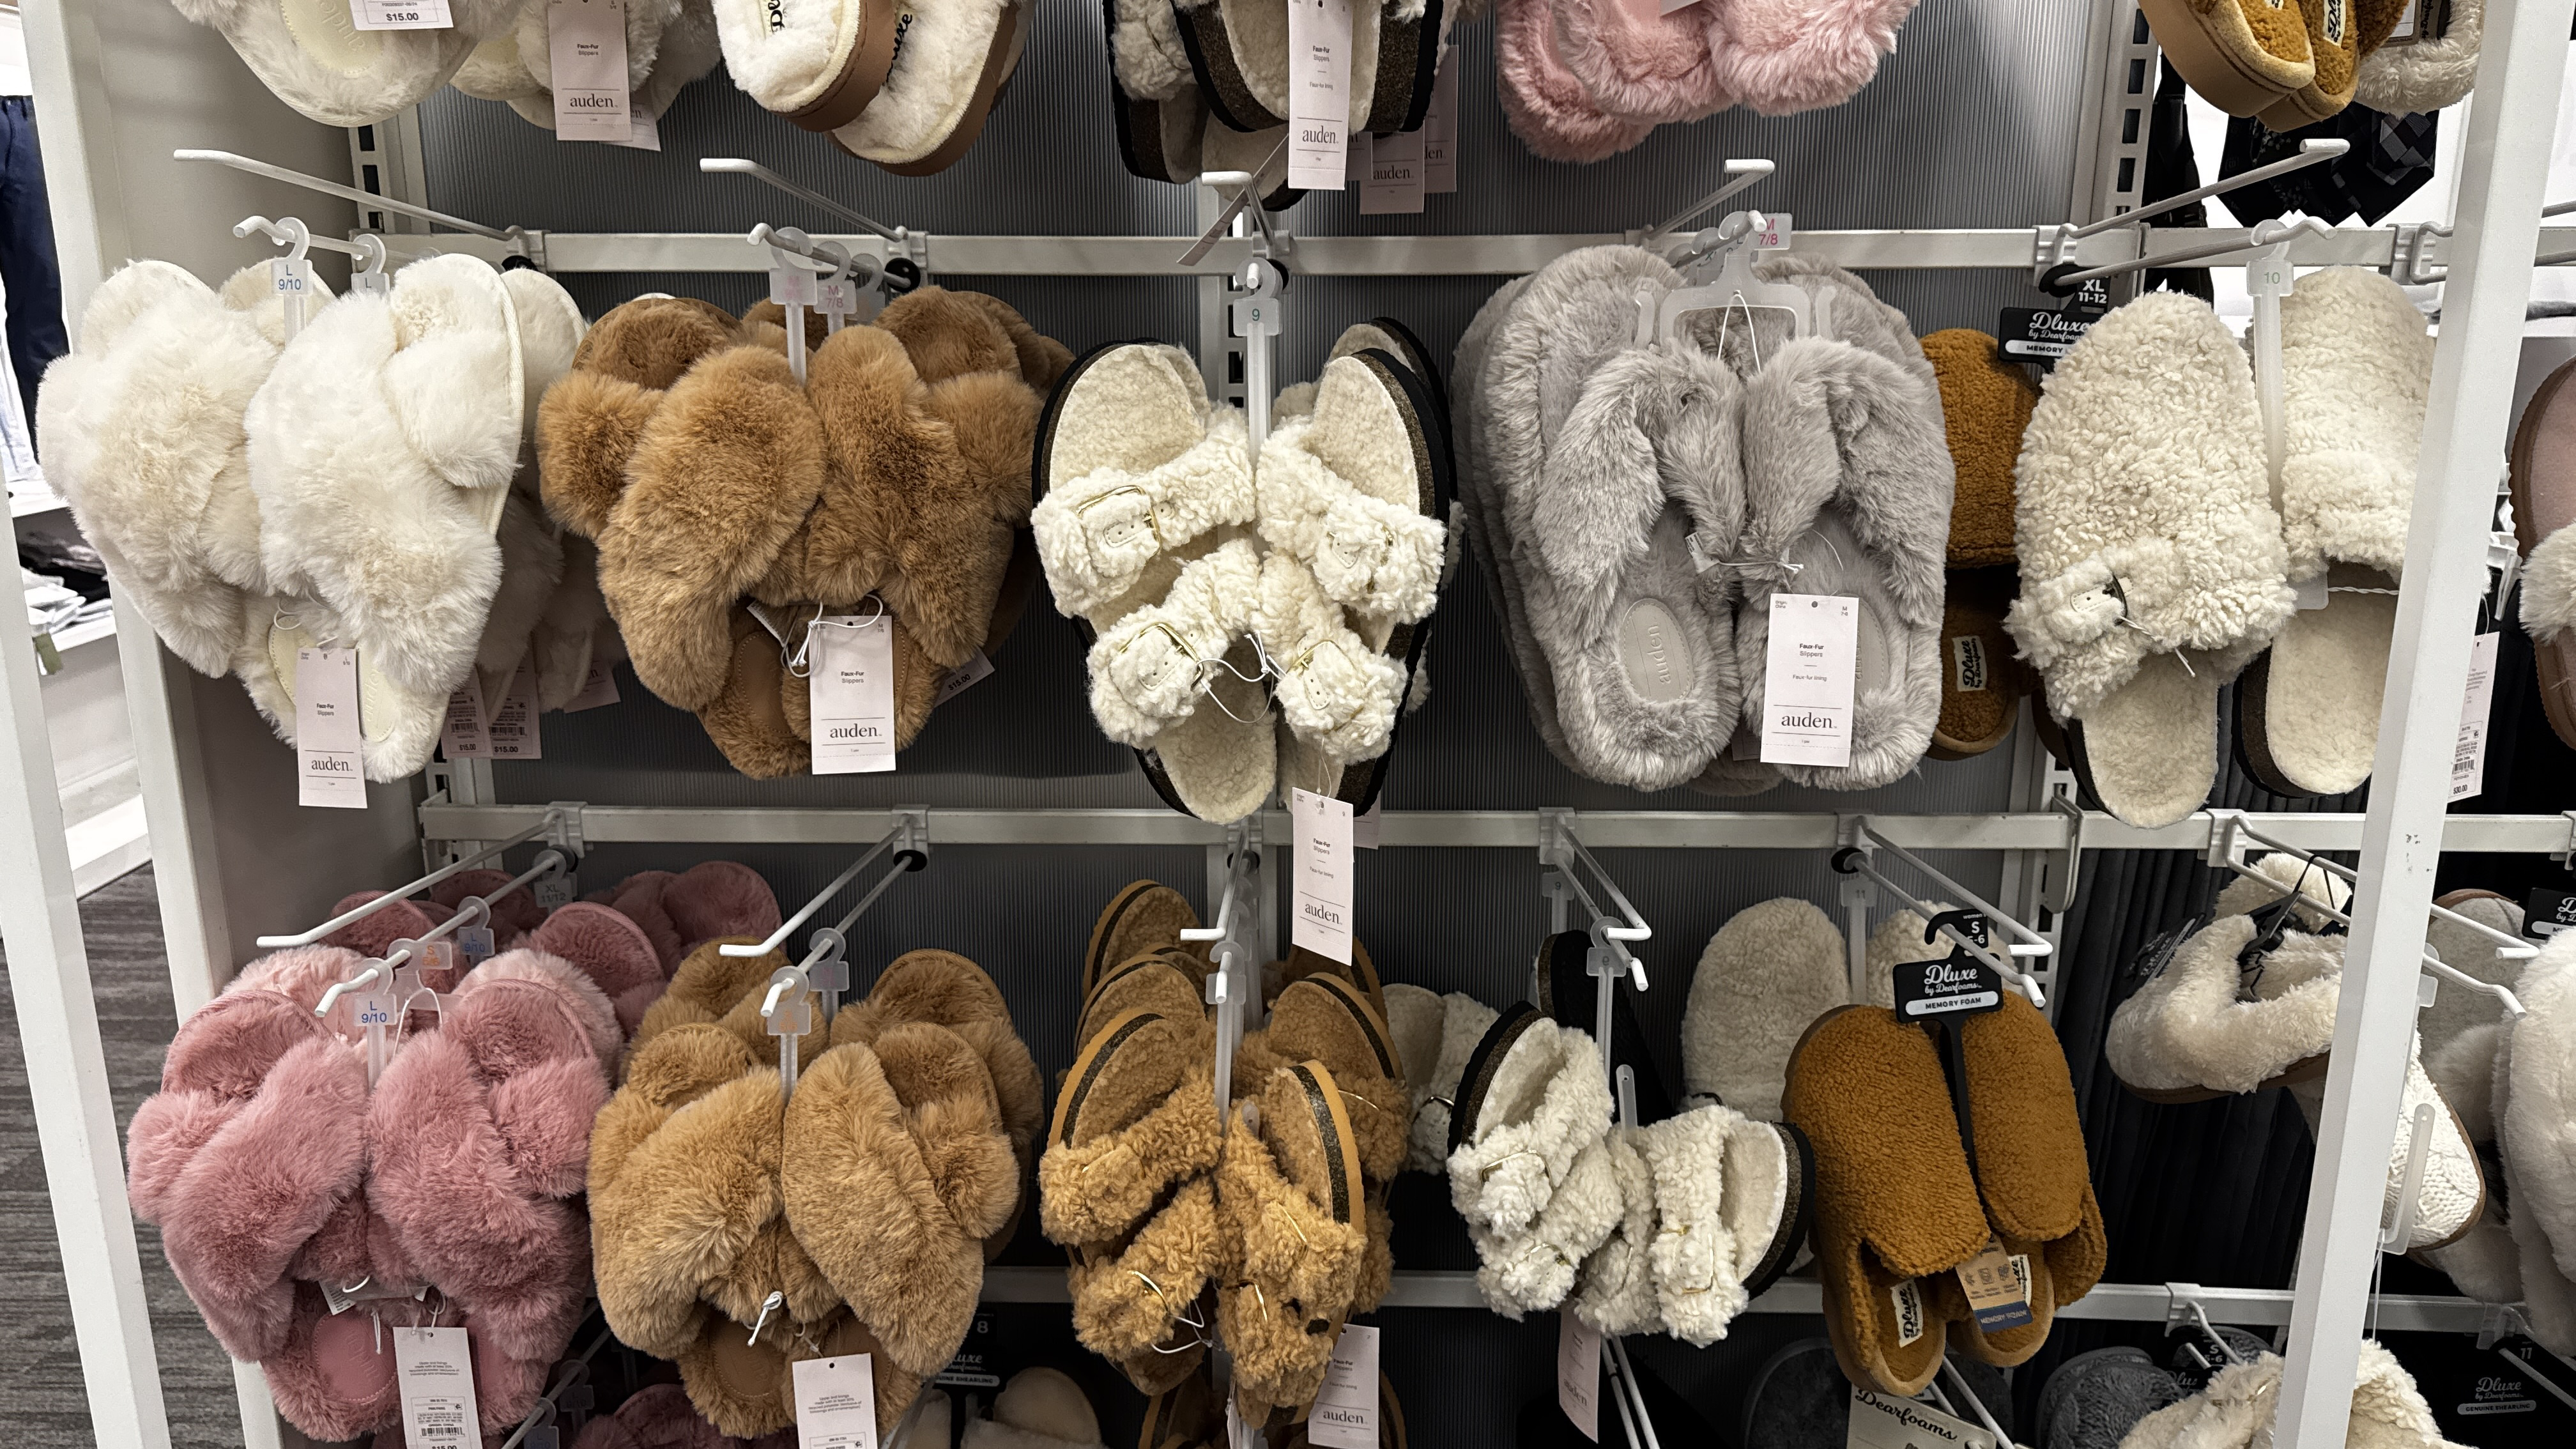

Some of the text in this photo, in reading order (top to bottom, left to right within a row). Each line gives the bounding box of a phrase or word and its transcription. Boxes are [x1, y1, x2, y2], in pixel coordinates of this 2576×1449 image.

[386, 13, 419, 22] $15.00
[570, 93, 614, 108] auden
[1302, 125, 1337, 144] auden
[1374, 165, 1411, 181] auden
[1758, 234, 1779, 246] 7/8
[286, 264, 293, 276] L
[365, 277, 372, 289] L
[2264, 272, 2281, 284] 10
[278, 279, 302, 291] 9/10
[827, 285, 839, 296] M
[2082, 279, 2105, 293] XL
[825, 298, 844, 308] 7/8
[2078, 292, 2108, 304] 11-12
[1252, 308, 1261, 321] 9
[2029, 311, 2090, 333] Dluxe
[2028, 328, 2082, 342] by Dearfoam
[2026, 345, 2064, 353] MEMORY
[1646, 624, 1671, 685] auden
[1961, 640, 1975, 687] Dluxe
[948, 673, 971, 691] $15.00
[1781, 712, 1834, 729] auden
[829, 723, 878, 739] auden
[310, 756, 349, 772] auden
[546, 884, 559, 893] XL
[1554, 881, 1561, 891] 9
[1305, 903, 1340, 924] auden
[2556, 912, 2566, 923] by
[1971, 921, 1980, 934] S
[1924, 963, 1978, 985] Dluxe
[1924, 982, 1978, 997] by Dearfoams
[370, 1001, 378, 1011] L
[1925, 997, 1982, 1009] MEMORY FOAM
[361, 1012, 388, 1023] 9/10
[1899, 1287, 1914, 1338] Dluxe
[976, 1320, 989, 1334] 8
[2209, 1344, 2220, 1354] S
[2520, 1347, 2533, 1360] 11
[956, 1354, 983, 1364] uxe
[2475, 1377, 2522, 1392] Dluxe
[2474, 1392, 2484, 1402] by
[1323, 1410, 1364, 1425] auden
[1855, 1388, 1958, 1440] Dearfoams
